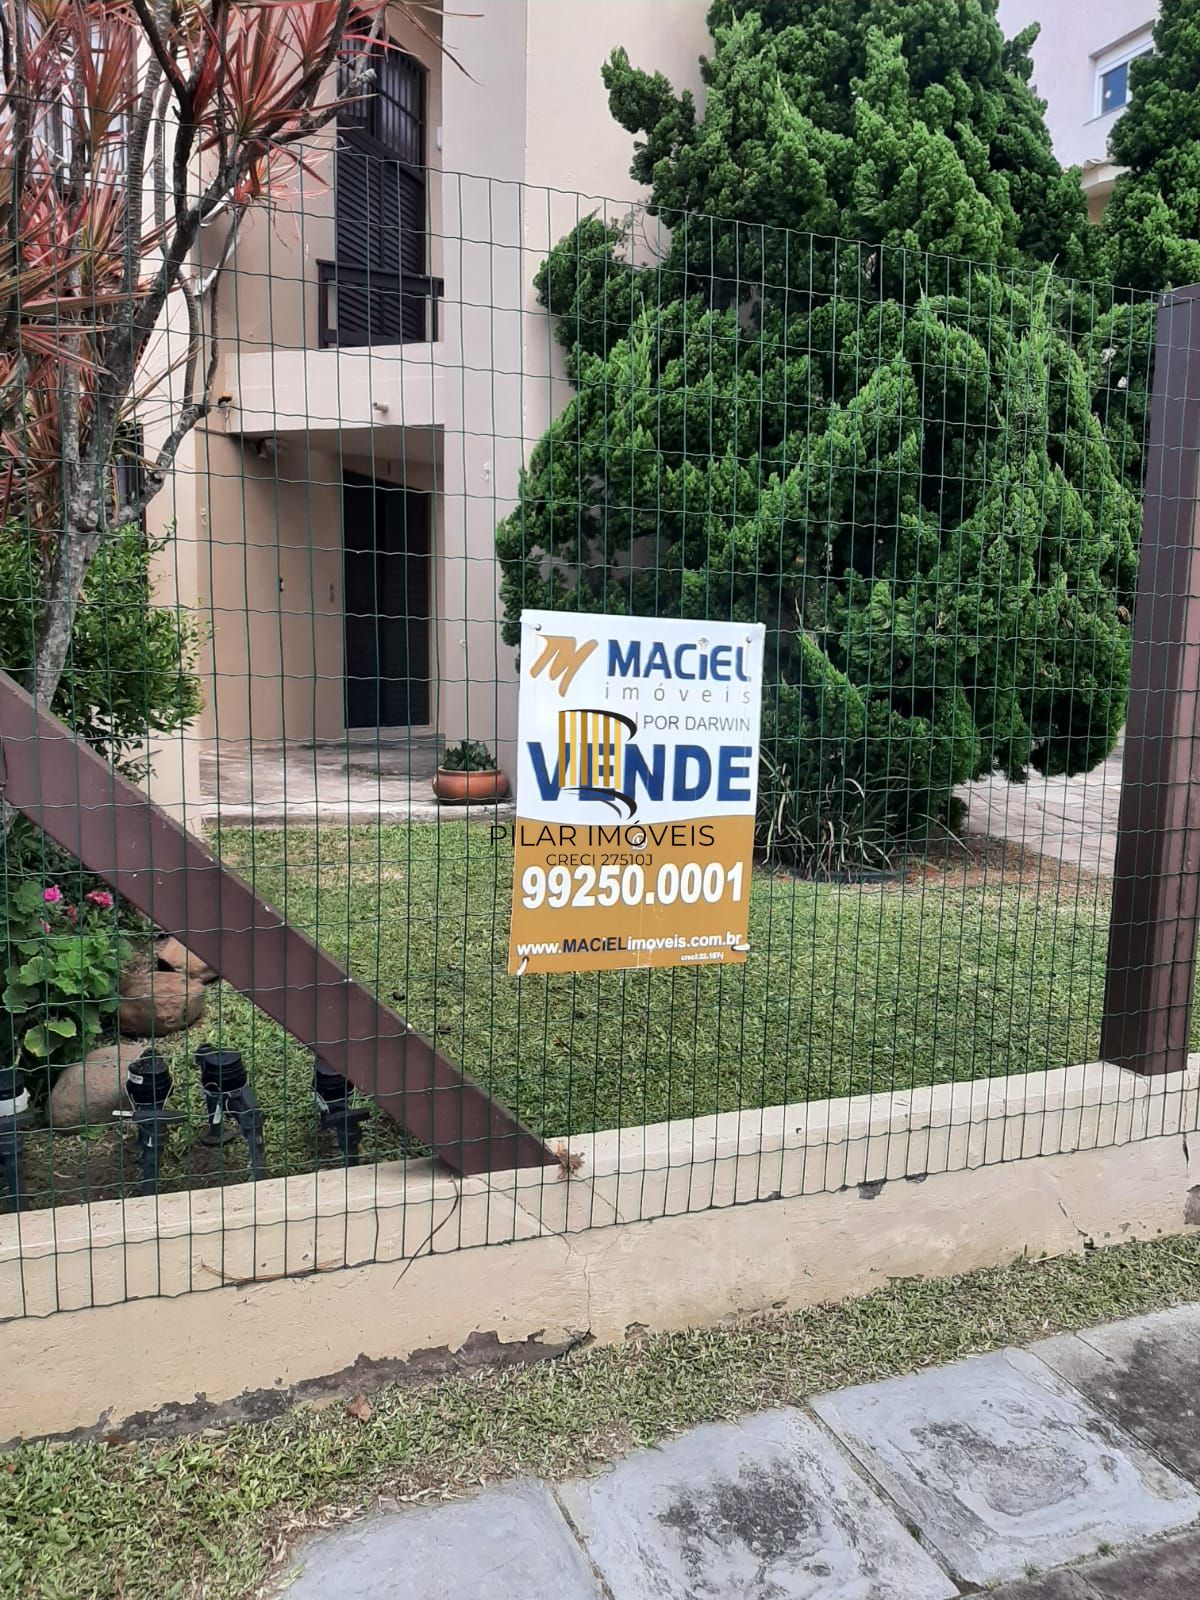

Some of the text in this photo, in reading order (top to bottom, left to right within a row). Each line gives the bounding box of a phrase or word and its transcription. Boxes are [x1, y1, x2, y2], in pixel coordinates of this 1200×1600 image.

[605, 682, 751, 703] imóveis
[643, 715, 750, 732] POR DARWIN
[526, 741, 753, 802] VENDE
[521, 861, 744, 910] 99250.0001
